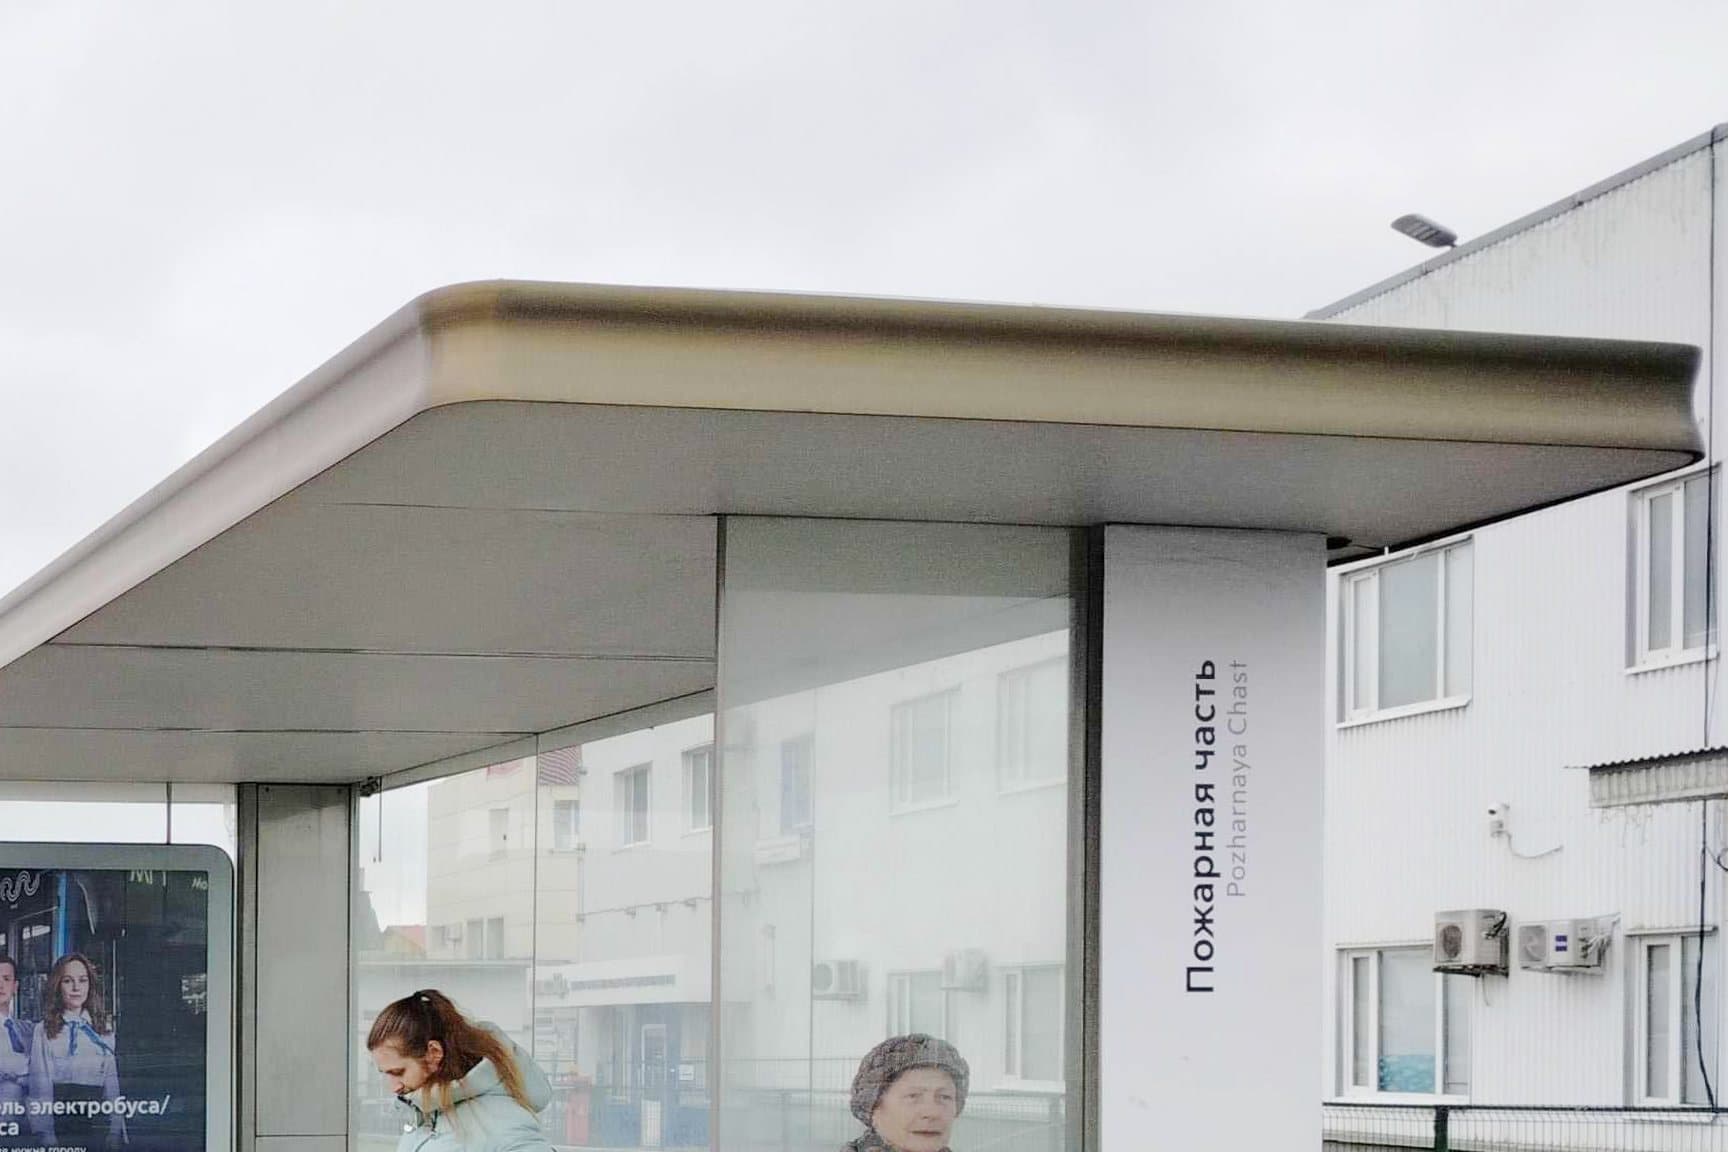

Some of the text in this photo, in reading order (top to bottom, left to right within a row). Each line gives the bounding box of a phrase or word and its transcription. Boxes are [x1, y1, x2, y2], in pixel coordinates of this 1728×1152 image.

[1186, 659, 1222, 993] Пожарная часть
[1225, 658, 1251, 898] Pozharnaya Chast
[30, 1094, 171, 1119] электробуса/
